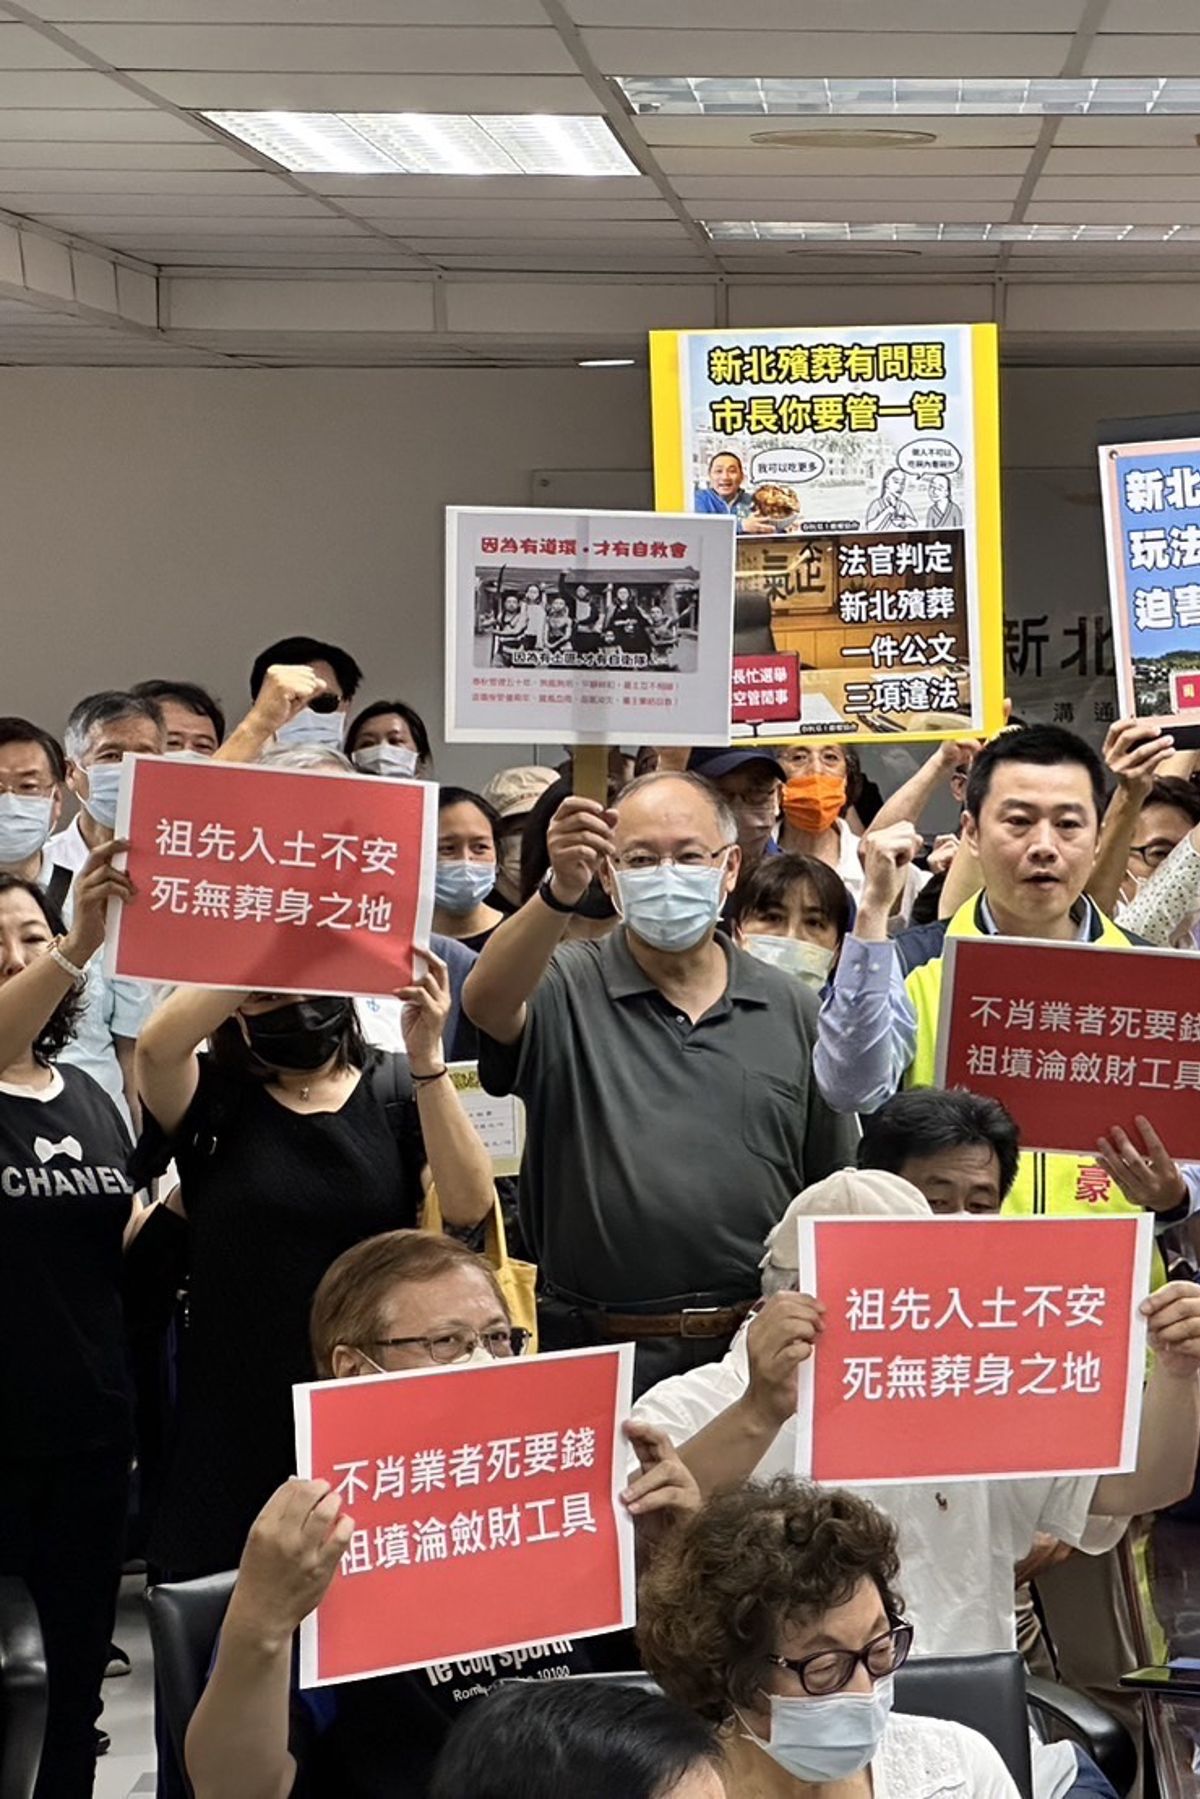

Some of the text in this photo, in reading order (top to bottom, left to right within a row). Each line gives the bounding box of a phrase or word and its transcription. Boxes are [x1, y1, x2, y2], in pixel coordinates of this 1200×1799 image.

[708, 342, 946, 384] 新北殯葬有問題
[711, 393, 946, 434] 市長你要管一管
[757, 461, 818, 473] 我可以吃更多
[838, 543, 954, 578] 法官判定
[838, 588, 956, 624] 新北殯葬
[841, 633, 958, 669] 一件公文
[731, 667, 788, 685] 長忙選舉
[843, 681, 960, 716] 三項違法
[155, 818, 399, 876] 祖先入土不安
[150, 875, 393, 933] 死無葬身之地
[1, 1165, 134, 1197] CHANEL
[1075, 1164, 1111, 1202] 豪
[845, 1284, 1107, 1332] 祖先入土不安
[841, 1350, 1102, 1401] 死無葬身之地
[333, 1427, 596, 1506] 不肖業者死要錢
